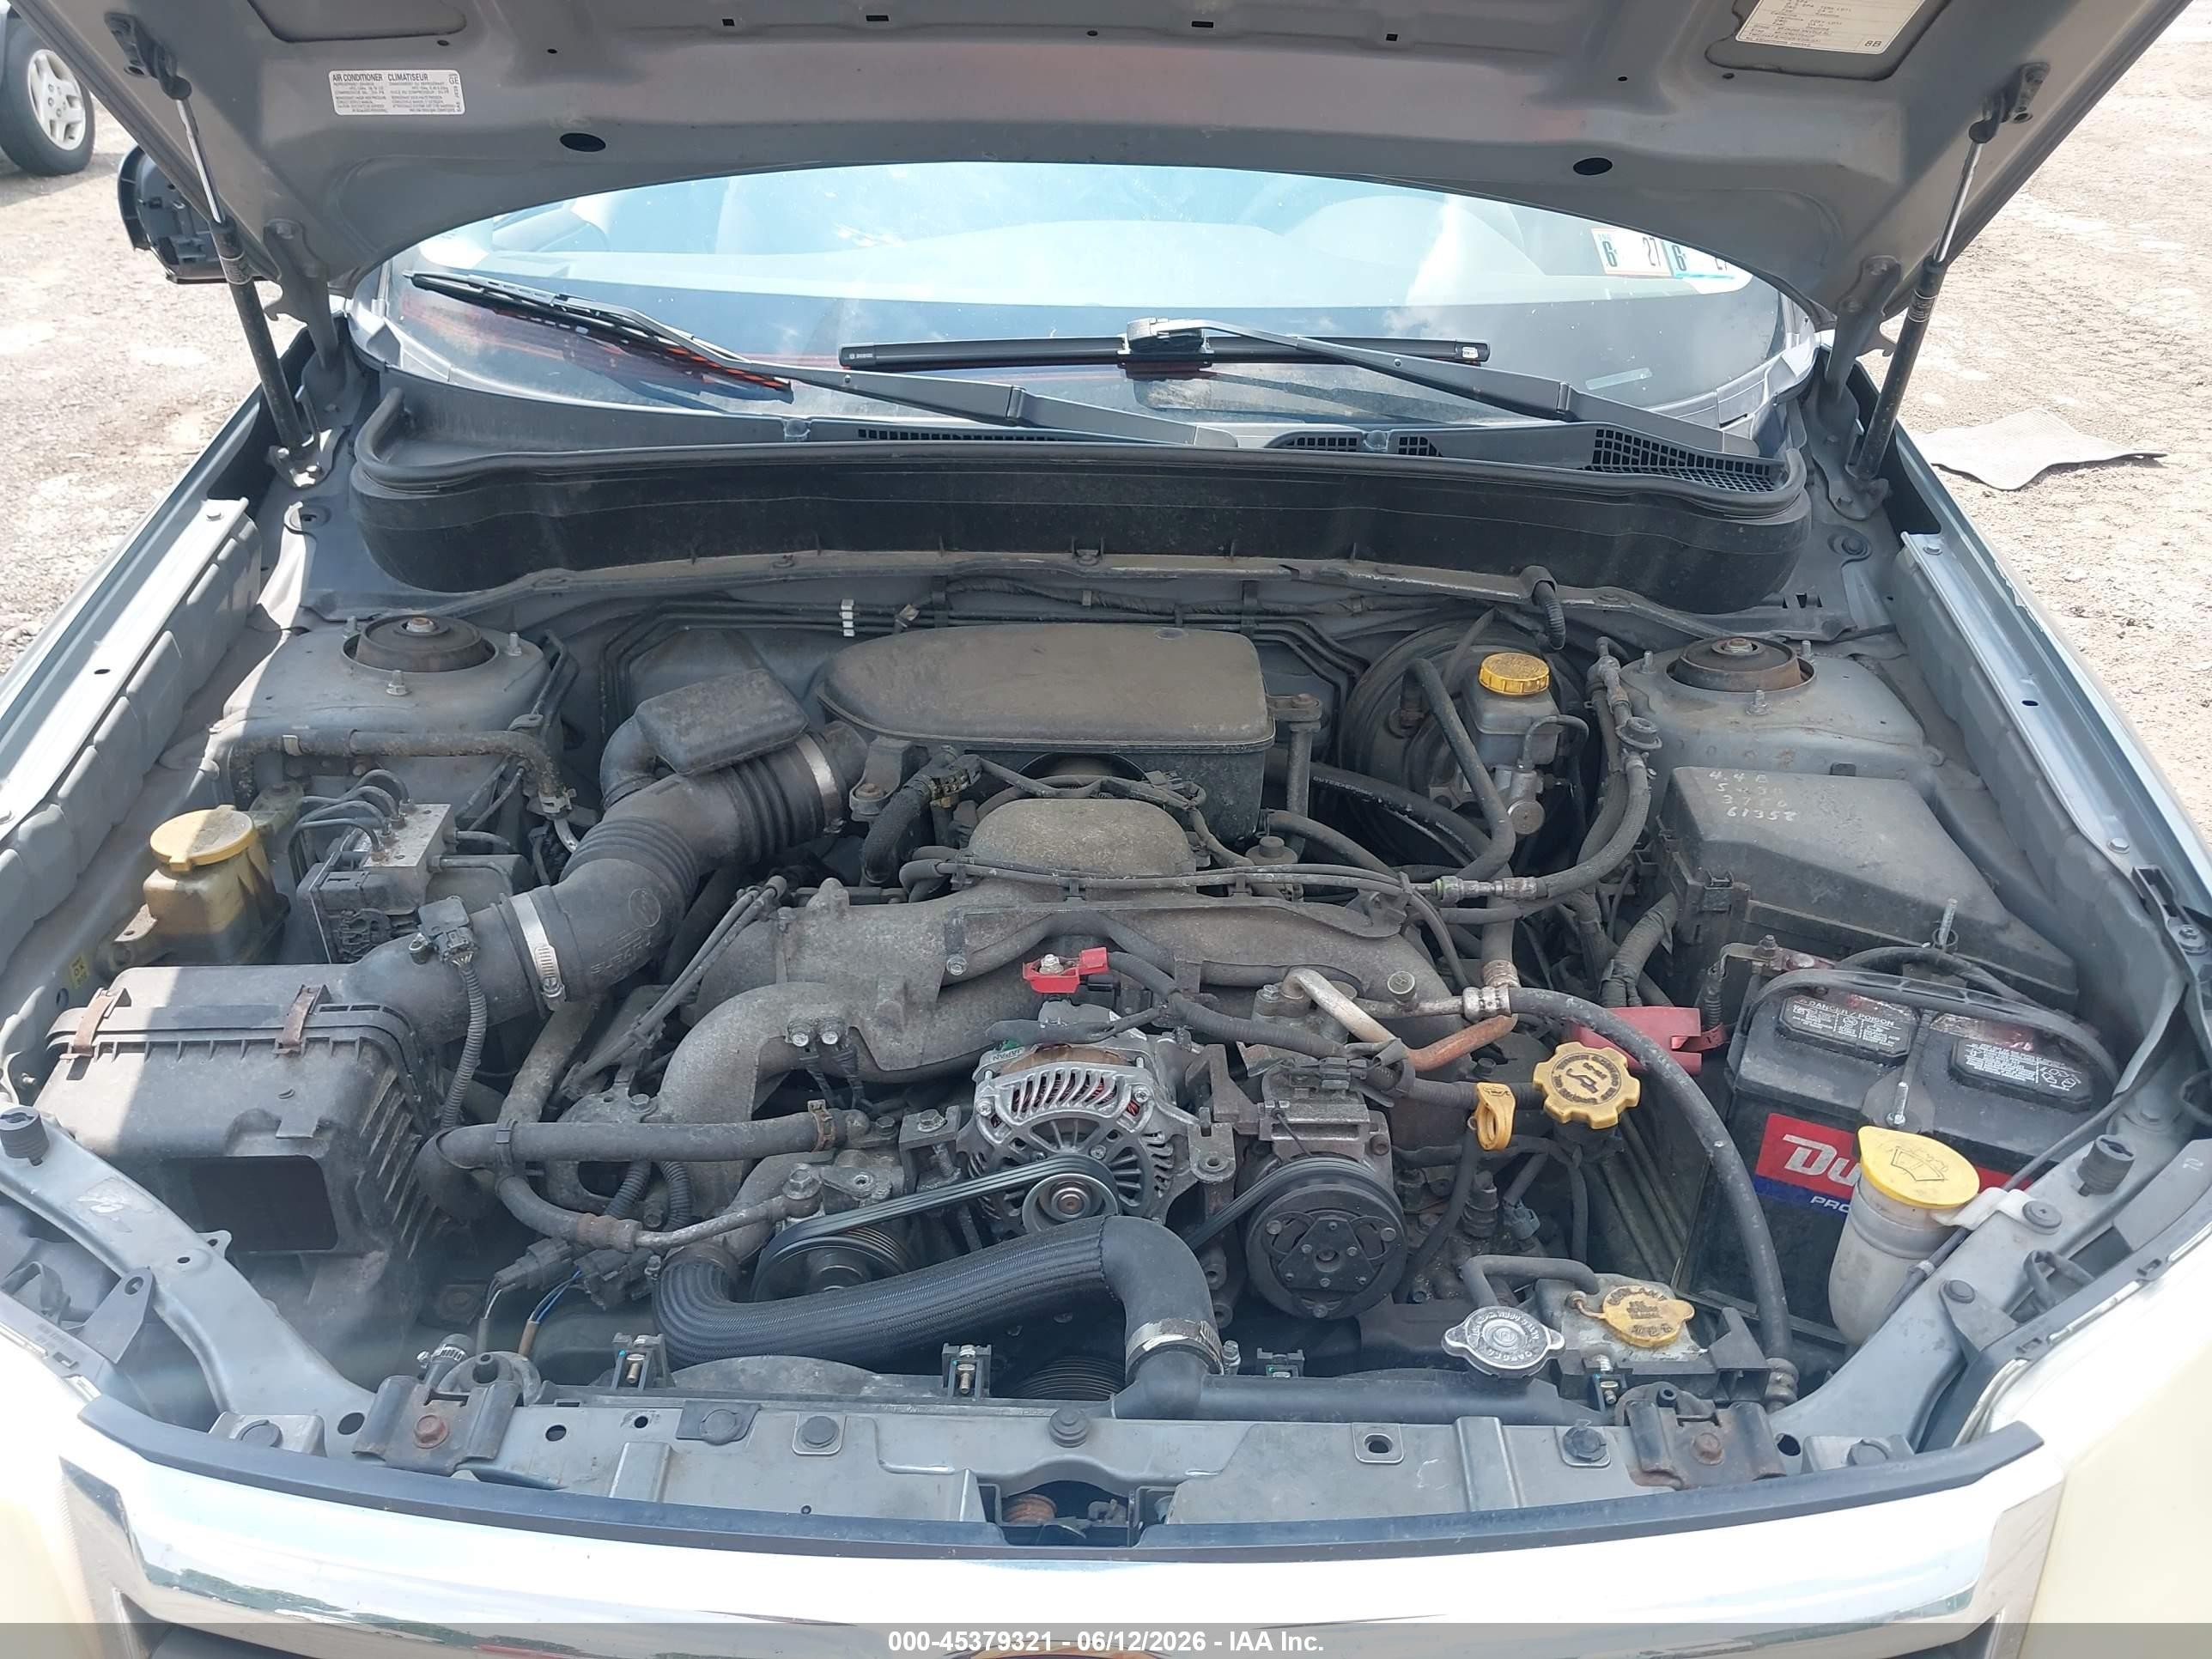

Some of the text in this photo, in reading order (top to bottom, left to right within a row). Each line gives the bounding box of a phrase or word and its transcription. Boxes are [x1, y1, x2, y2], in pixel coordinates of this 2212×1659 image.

[1863, 40, 1882, 48] 8B
[387, 73, 428, 82] CLIMATISEUR
[1602, 236, 1662, 267] 6 27
[1671, 245, 1687, 271] 6
[1808, 1000, 1849, 1016] DANGER
[1858, 1012, 1896, 1026] POISON
